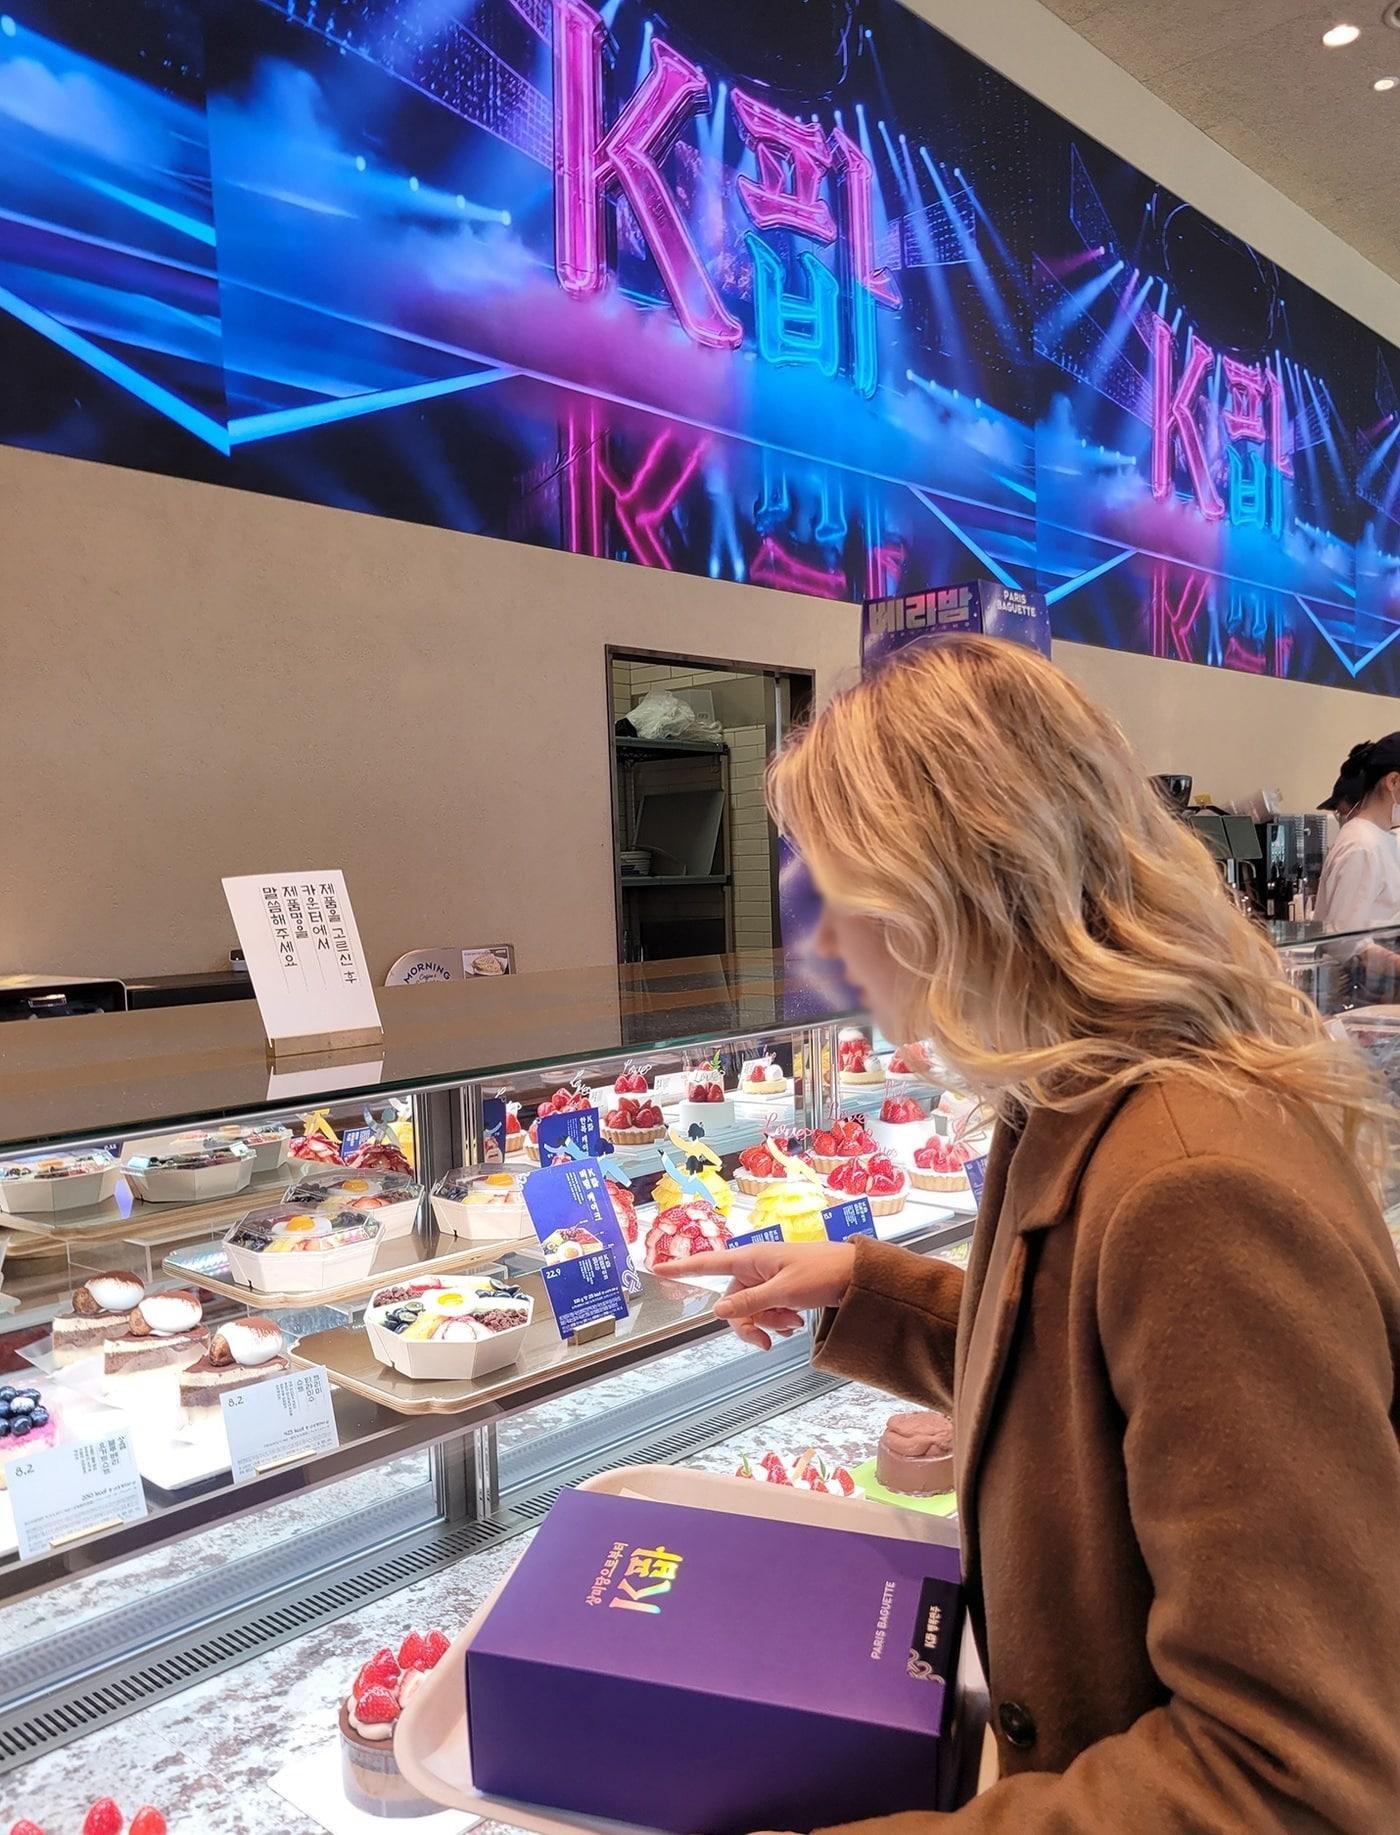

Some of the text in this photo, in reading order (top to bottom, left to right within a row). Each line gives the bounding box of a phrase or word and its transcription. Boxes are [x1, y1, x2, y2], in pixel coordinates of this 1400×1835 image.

[997, 600, 1037, 618] BAGUETTE
[1003, 589, 1027, 604] PARIS
[262, 887, 298, 968] 말씀해 주세요
[281, 885, 309, 939] 제품명을
[301, 884, 330, 950] 카운터에서
[318, 883, 358, 984] 제품을 고르신 후
[403, 961, 451, 984] MORNING
[545, 1268, 561, 1279] 22.9
[585, 1541, 629, 1607] 상미당으로부터
[609, 1546, 684, 1614] K팝
[870, 1581, 896, 1660] PARIS BAGUETTE
